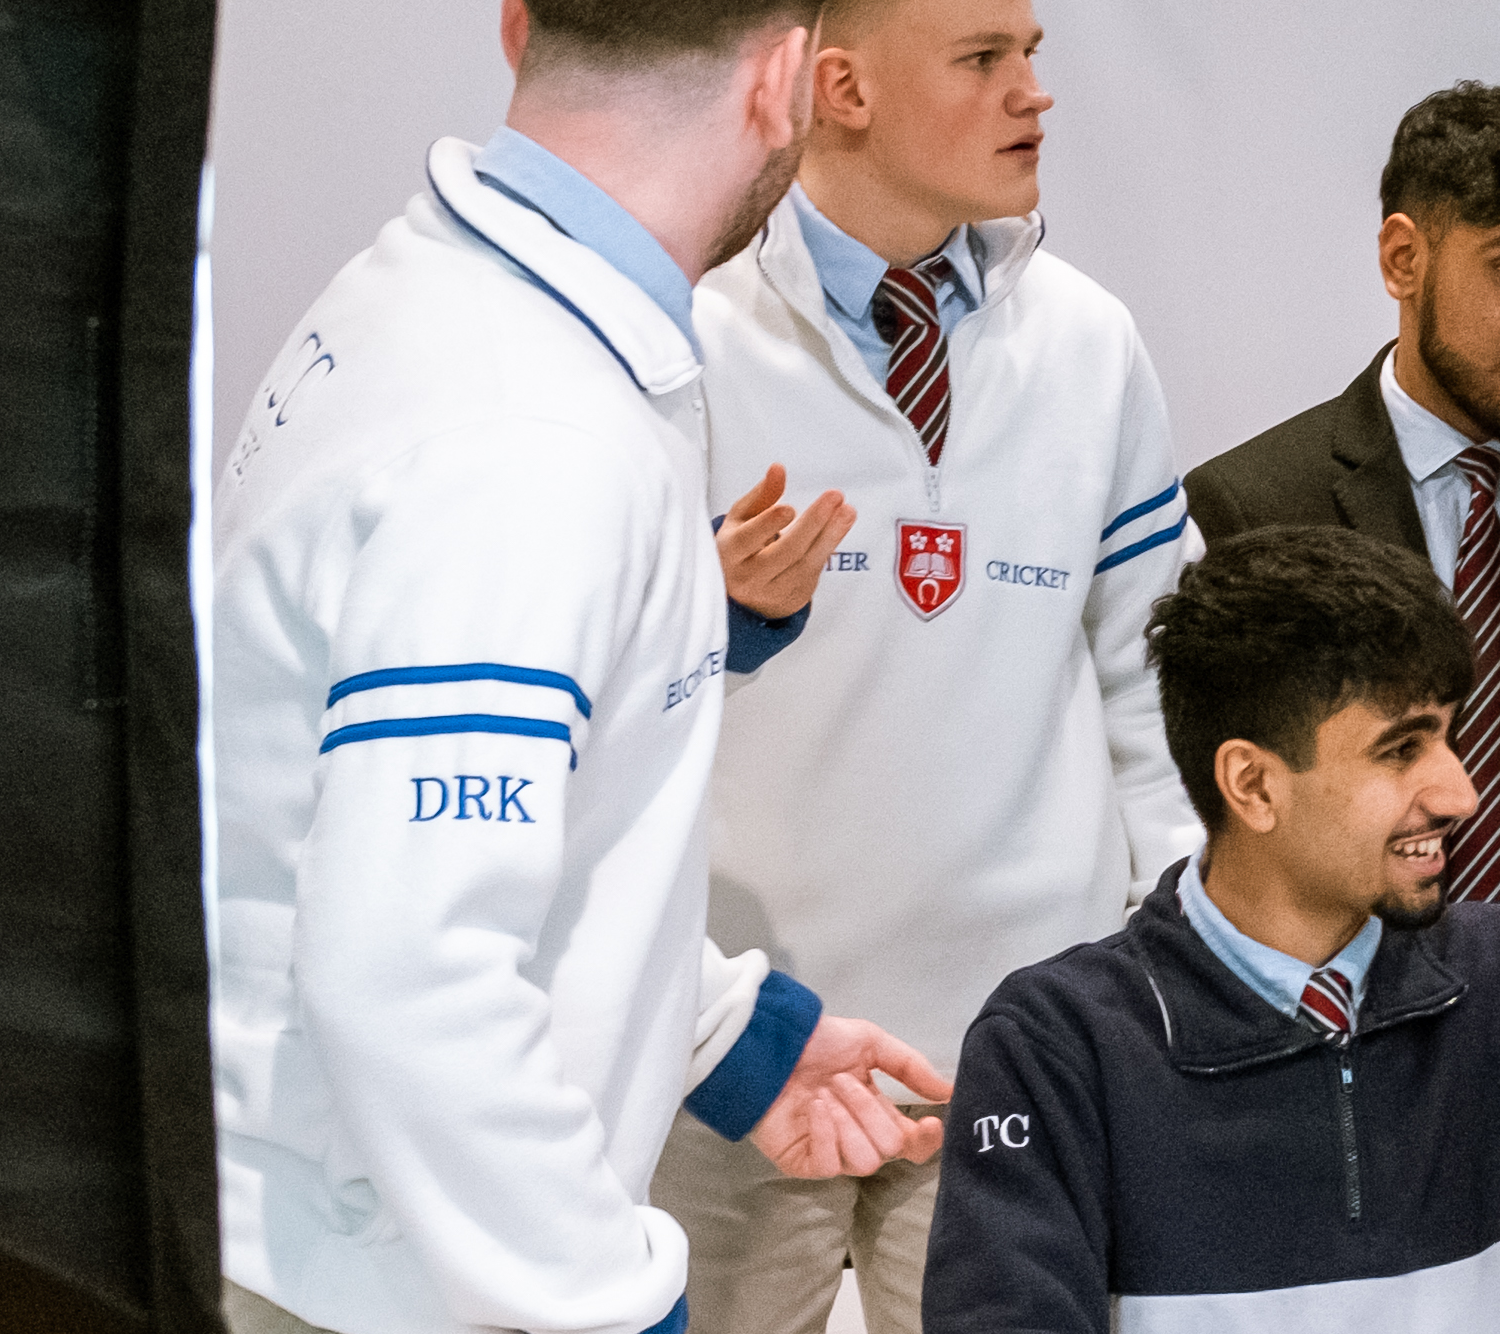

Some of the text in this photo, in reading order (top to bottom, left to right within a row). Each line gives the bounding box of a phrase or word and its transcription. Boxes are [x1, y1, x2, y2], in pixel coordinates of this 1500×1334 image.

[986, 560, 1070, 591] CRICKET
[409, 774, 536, 823] DRK
[973, 1113, 1030, 1153] TC
